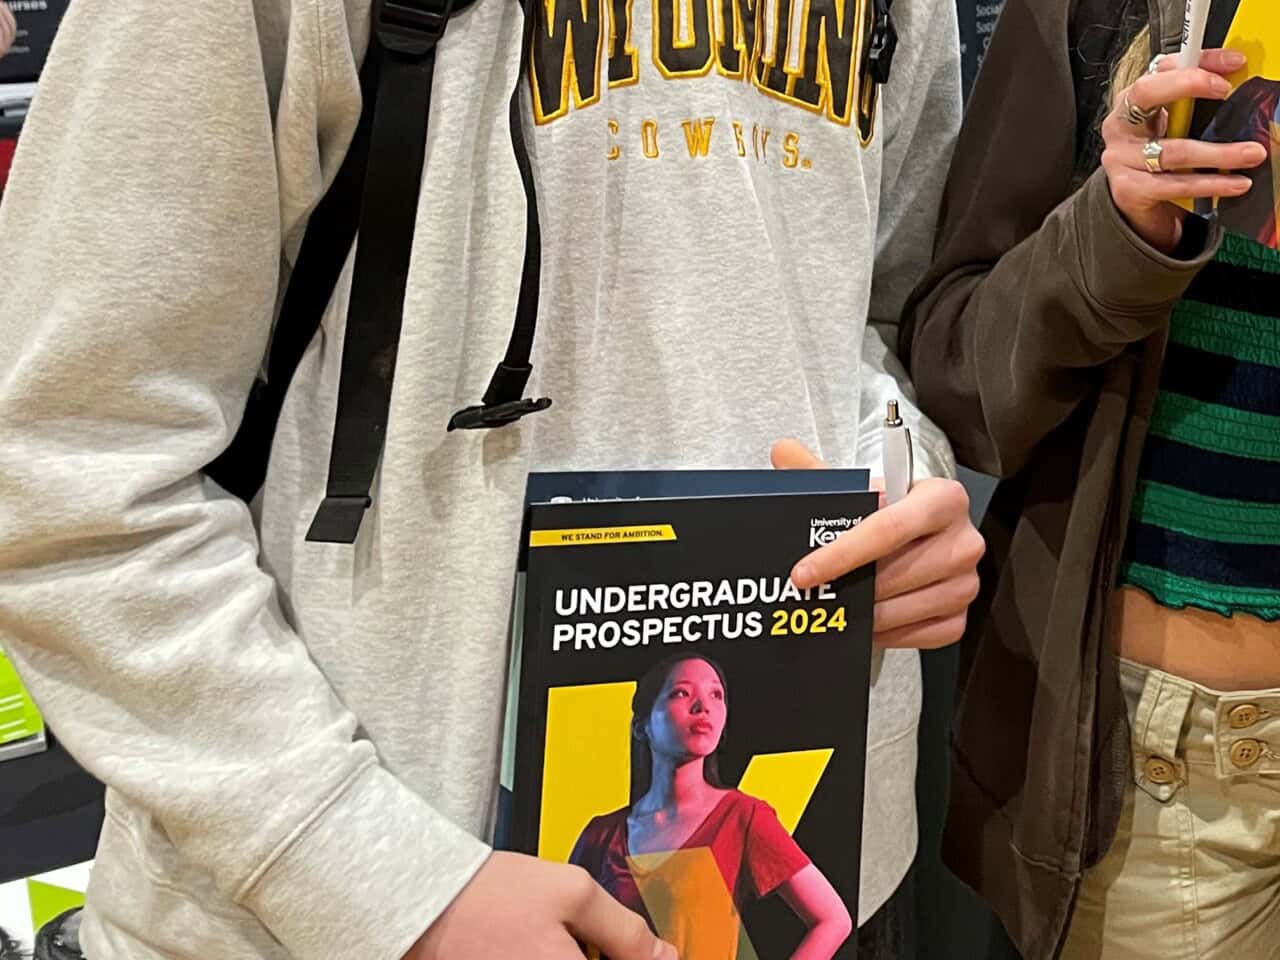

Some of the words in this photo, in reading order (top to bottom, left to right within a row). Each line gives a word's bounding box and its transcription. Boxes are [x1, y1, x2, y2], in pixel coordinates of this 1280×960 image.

[810, 518, 852, 528] University
[561, 534, 574, 542] WE
[576, 533, 602, 541] STAND
[604, 532, 621, 540] FOR
[622, 529, 663, 539] AMBITION.
[552, 612, 762, 652] PROSPECTUS
[770, 607, 848, 637] 2024
